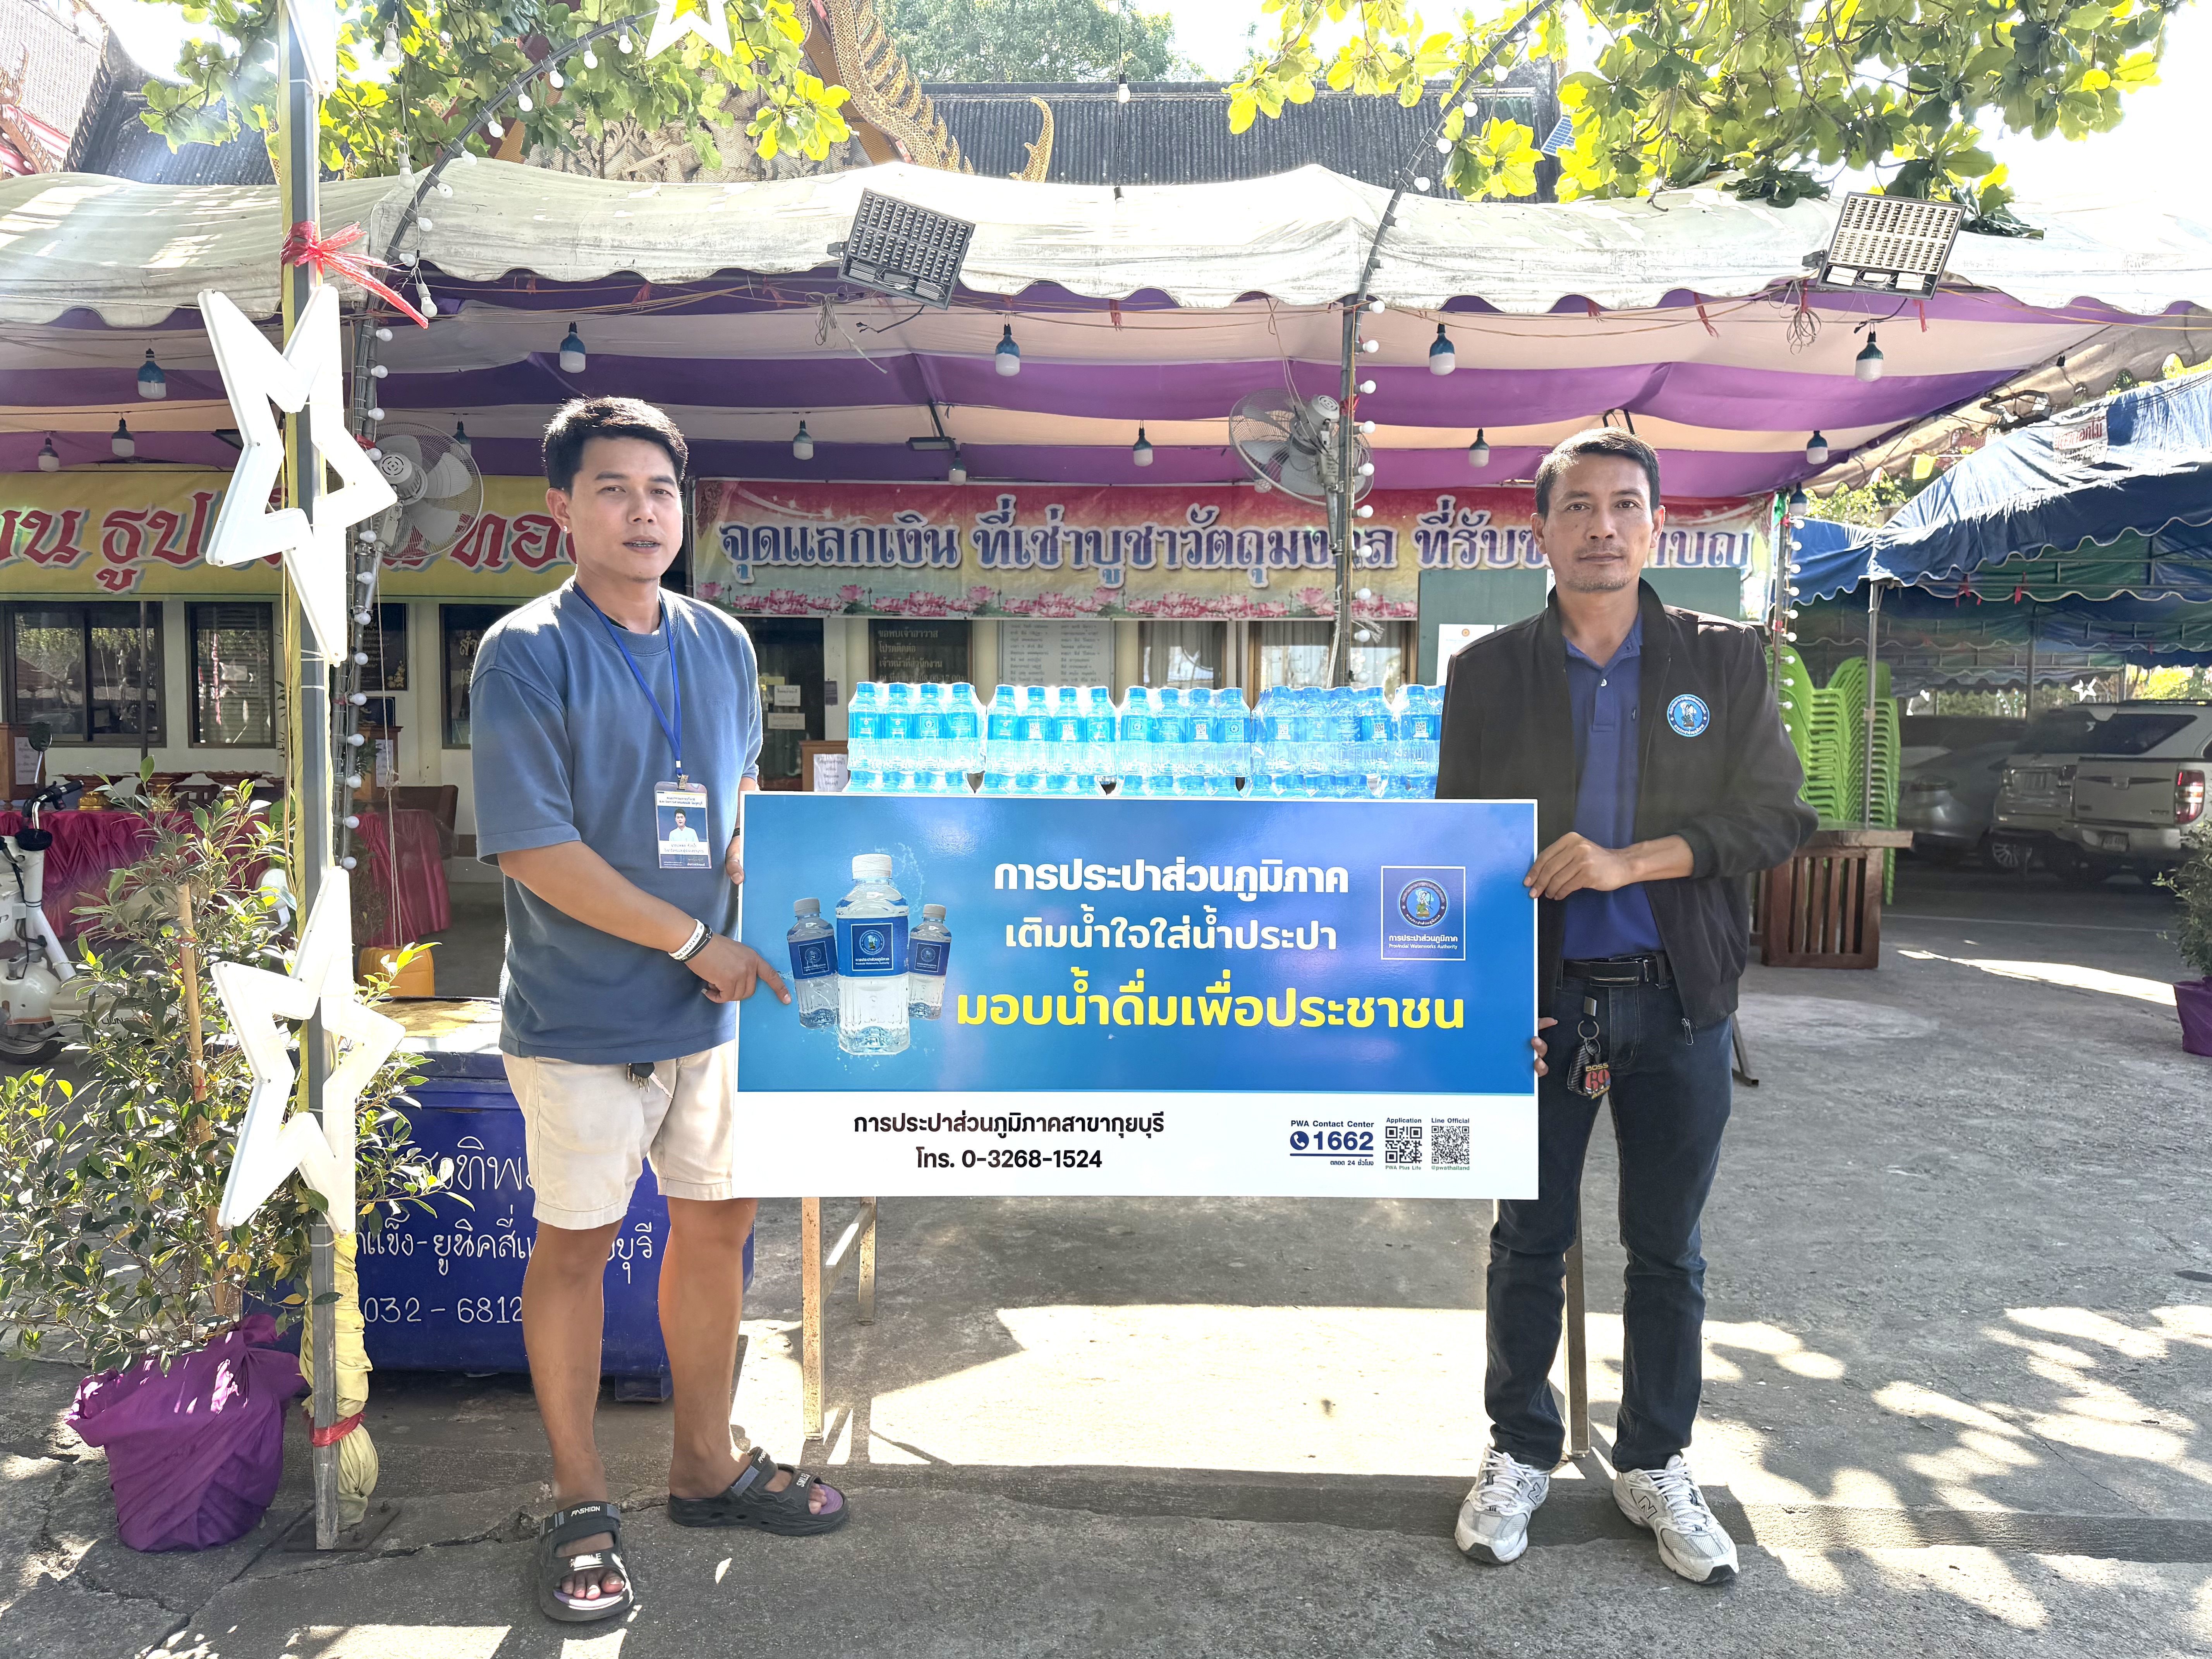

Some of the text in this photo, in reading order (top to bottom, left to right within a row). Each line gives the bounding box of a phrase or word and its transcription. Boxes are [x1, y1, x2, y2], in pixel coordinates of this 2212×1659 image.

[96, 490, 213, 591] ธูป
[719, 513, 961, 579] จุดแลกเงิน
[973, 498, 1395, 584] ที่เช่าบูชาวัตถุมงล
[994, 857, 1348, 902] การประปาส่วนภูมิภาค
[1006, 904, 1336, 950] เติมน้ำใจใส่น้ำประปา
[1389, 934, 1458, 943] การประปาส่วนภูมิภาค
[958, 967, 1464, 1029] มอบน้ำดื่มเพื่อประชาชน
[1586, 1063, 1609, 1072] BOSS
[854, 1110, 1164, 1139] การประปาส่วนภูมิภาคสาขากุยบุรี
[1313, 1131, 1374, 1151] 1662
[916, 1146, 1103, 1168] โทร. 0-3268-1524
[364, 1297, 422, 1322] 032
[457, 1296, 523, 1323] 6812
[571, 1506, 600, 1517] FASHION
